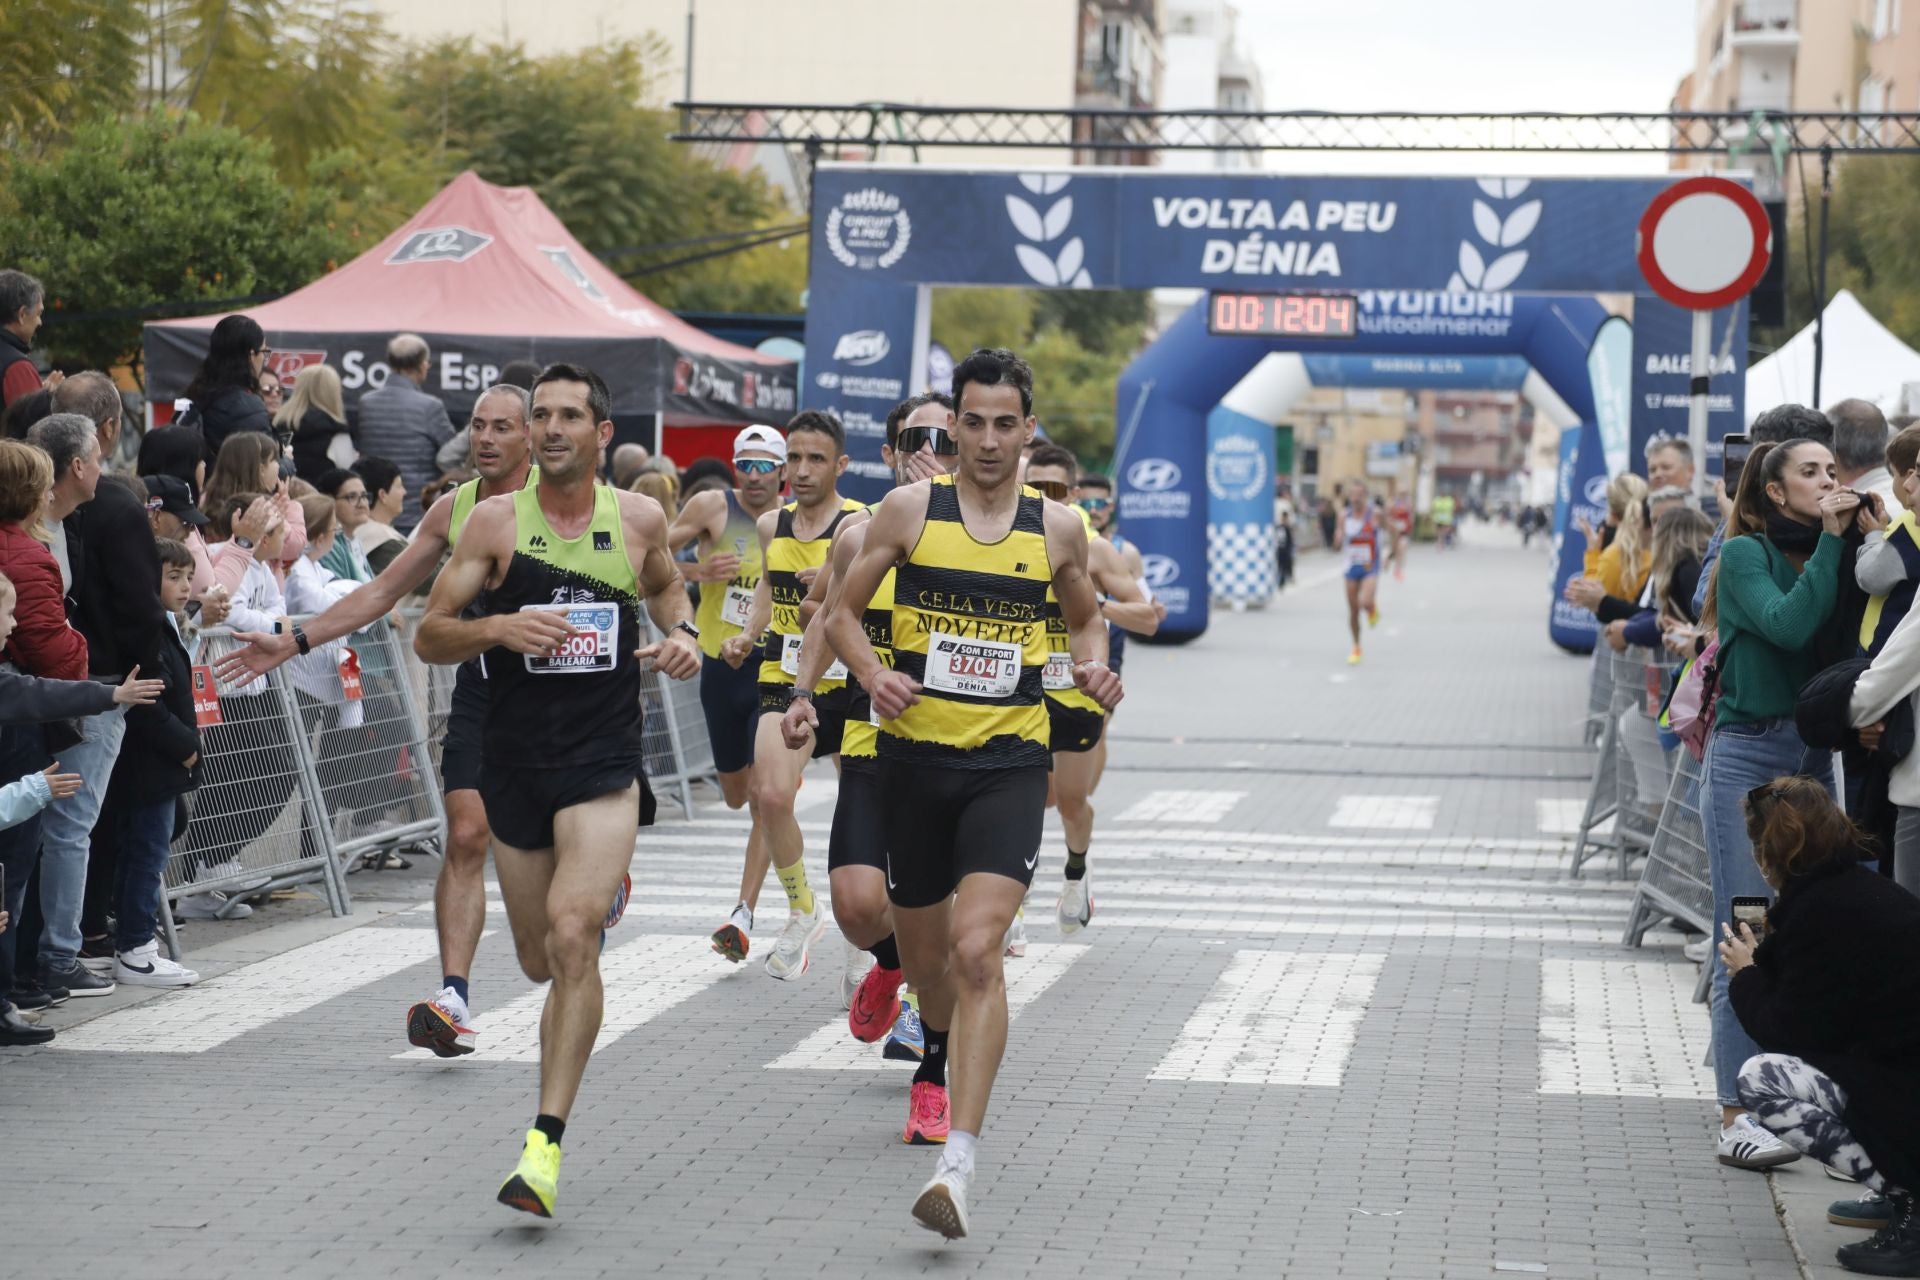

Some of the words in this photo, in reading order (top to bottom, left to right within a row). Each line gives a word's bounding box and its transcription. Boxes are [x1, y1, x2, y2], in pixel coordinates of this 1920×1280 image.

[1152, 197, 1276, 229] VOLTA
[1278, 200, 1310, 231] A
[1316, 201, 1397, 233] PEU
[1201, 232, 1342, 277] DÉNIA
[960, 645, 980, 656] SOM
[983, 649, 1013, 660] ESPORT
[951, 654, 996, 676] 3704
[957, 681, 988, 693] DÉNIA
